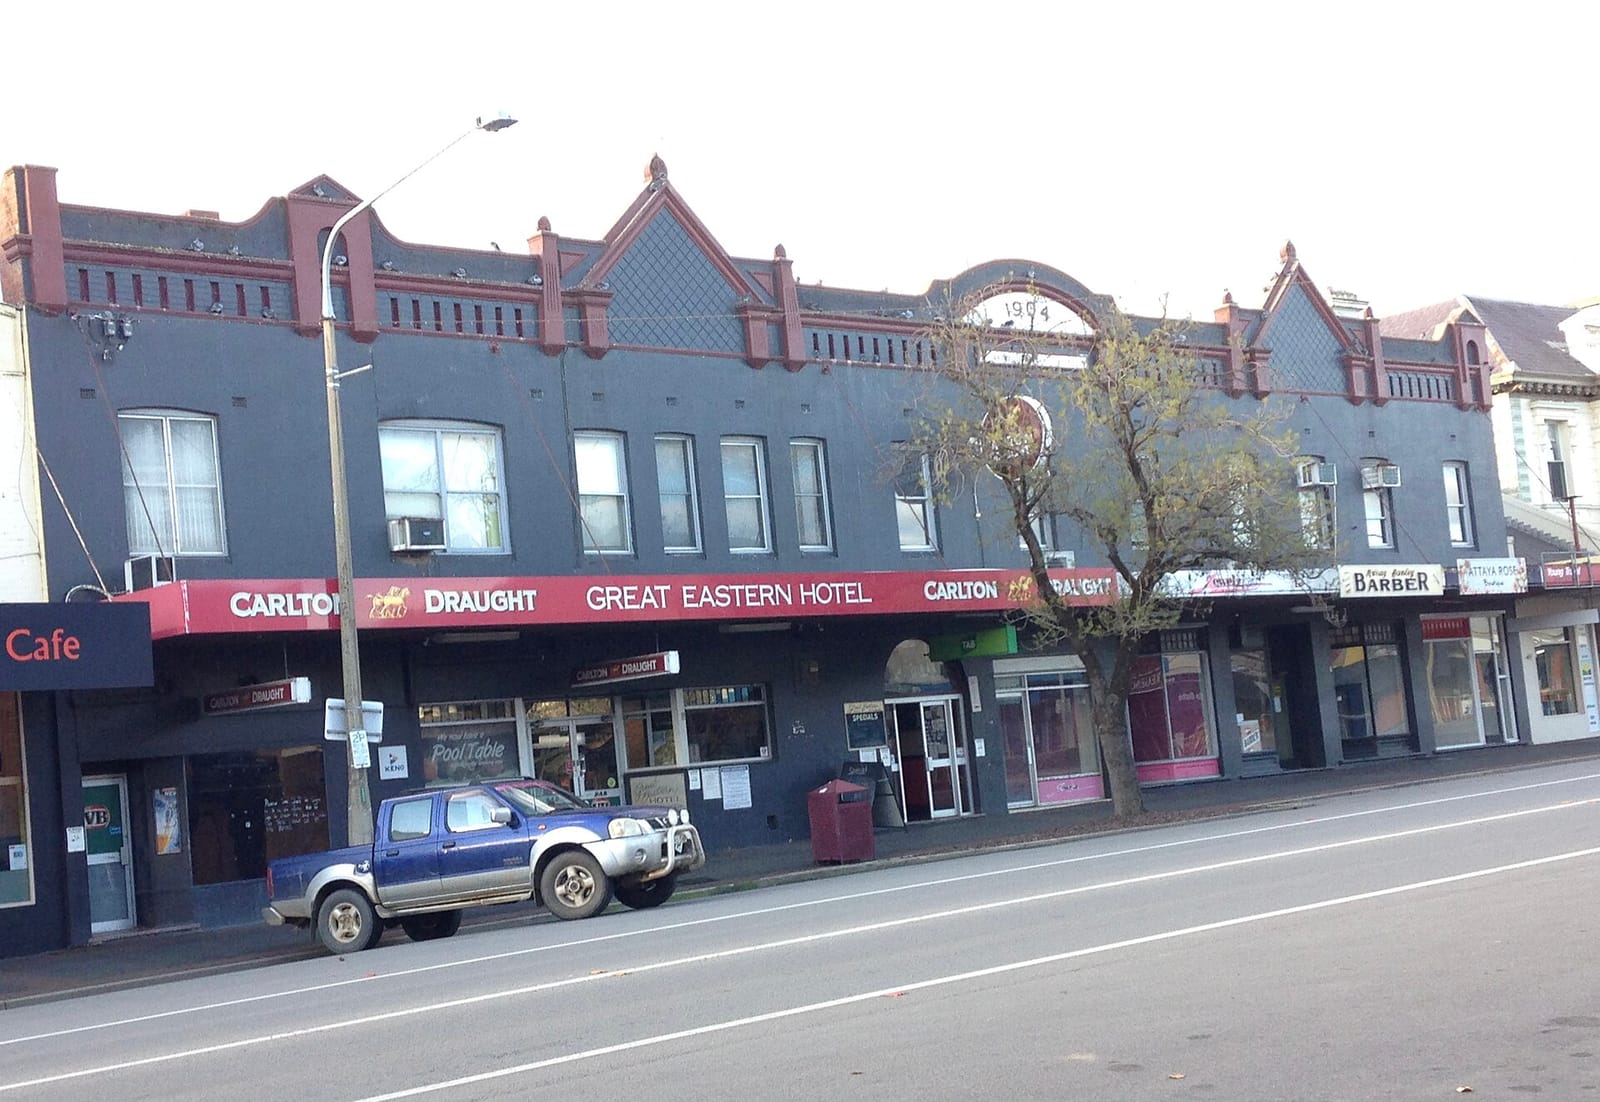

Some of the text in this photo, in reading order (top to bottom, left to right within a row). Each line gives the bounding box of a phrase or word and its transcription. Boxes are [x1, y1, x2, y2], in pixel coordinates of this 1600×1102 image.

[1005, 301, 1048, 321] 1904
[923, 578, 1112, 601] CARLTON RAUGHT
[1354, 572, 1429, 592] BARBER
[424, 589, 537, 613] DRAUGHT
[586, 582, 873, 611] GREAT EASTERN HOTEL
[5, 628, 81, 662] Cafe
[622, 660, 657, 674] DRAUGHT
[251, 688, 284, 703] DRAUGHT
[852, 713, 879, 722] SPECIALS
[352, 733, 365, 744] 2P
[432, 738, 505, 762] Pool Table
[384, 764, 405, 773] KENO
